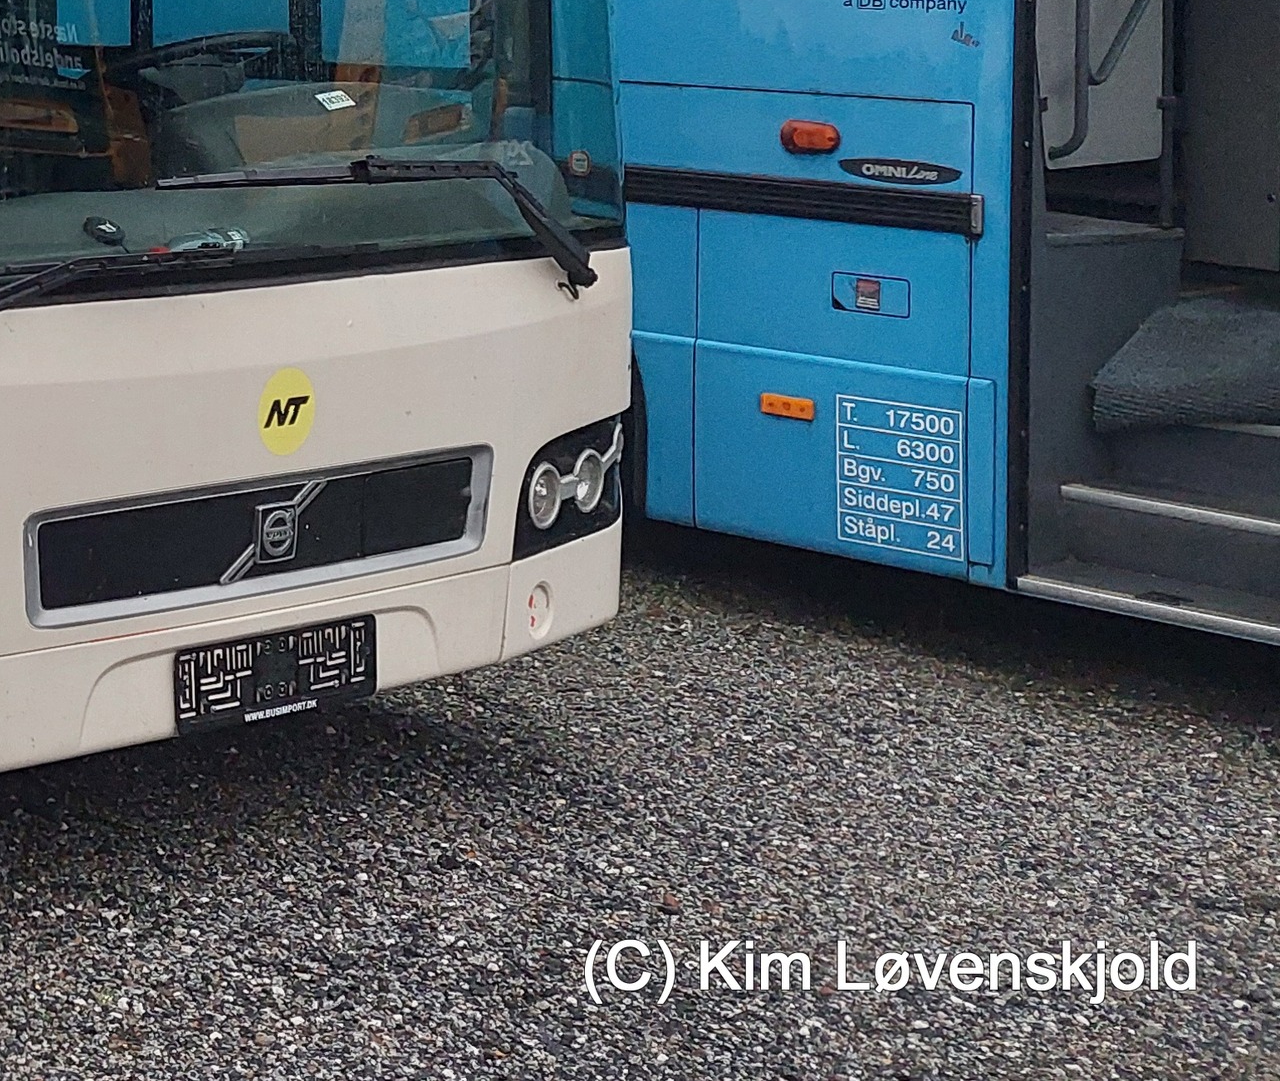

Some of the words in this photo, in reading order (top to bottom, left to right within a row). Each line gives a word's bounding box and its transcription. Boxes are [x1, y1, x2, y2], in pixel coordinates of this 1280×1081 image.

[263, 395, 311, 429] NT
[842, 402, 858, 422] T.
[886, 409, 954, 436] 17500
[843, 430, 860, 450] L.
[896, 439, 954, 464] 6300
[843, 458, 886, 483] Bgv.
[911, 469, 955, 493] 750
[844, 516, 901, 544] Ståpl.
[926, 531, 956, 552] 24
[244, 699, 318, 722] WWW.BUSIMPORT.DK
